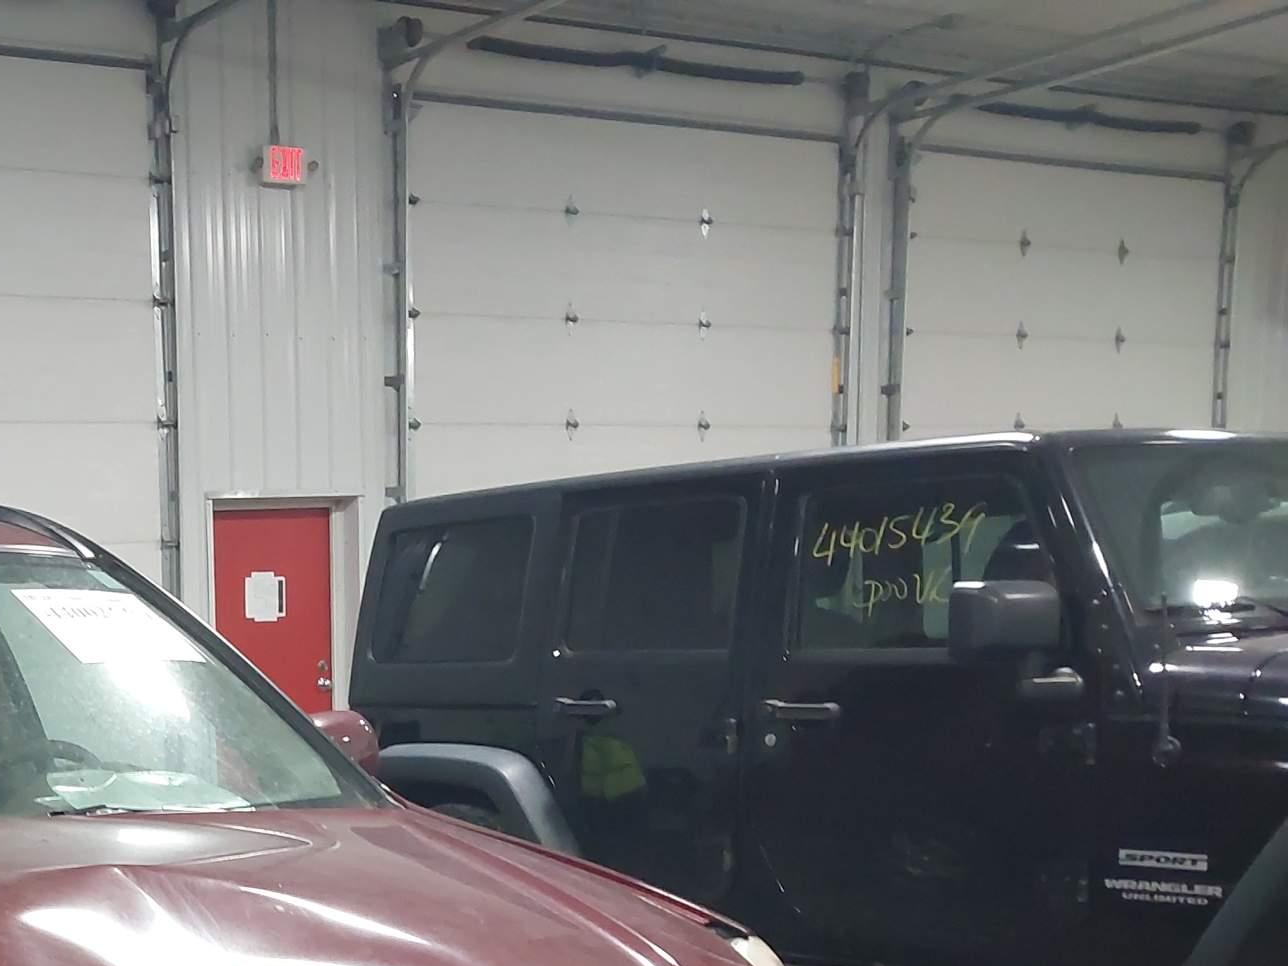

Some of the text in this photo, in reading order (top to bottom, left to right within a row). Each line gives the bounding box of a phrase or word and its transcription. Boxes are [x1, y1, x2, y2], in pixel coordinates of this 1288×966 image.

[1124, 853, 1206, 867] SPORT
[1104, 878, 1222, 898] WRANGLER
[1121, 891, 1209, 905] UNLIMITED
